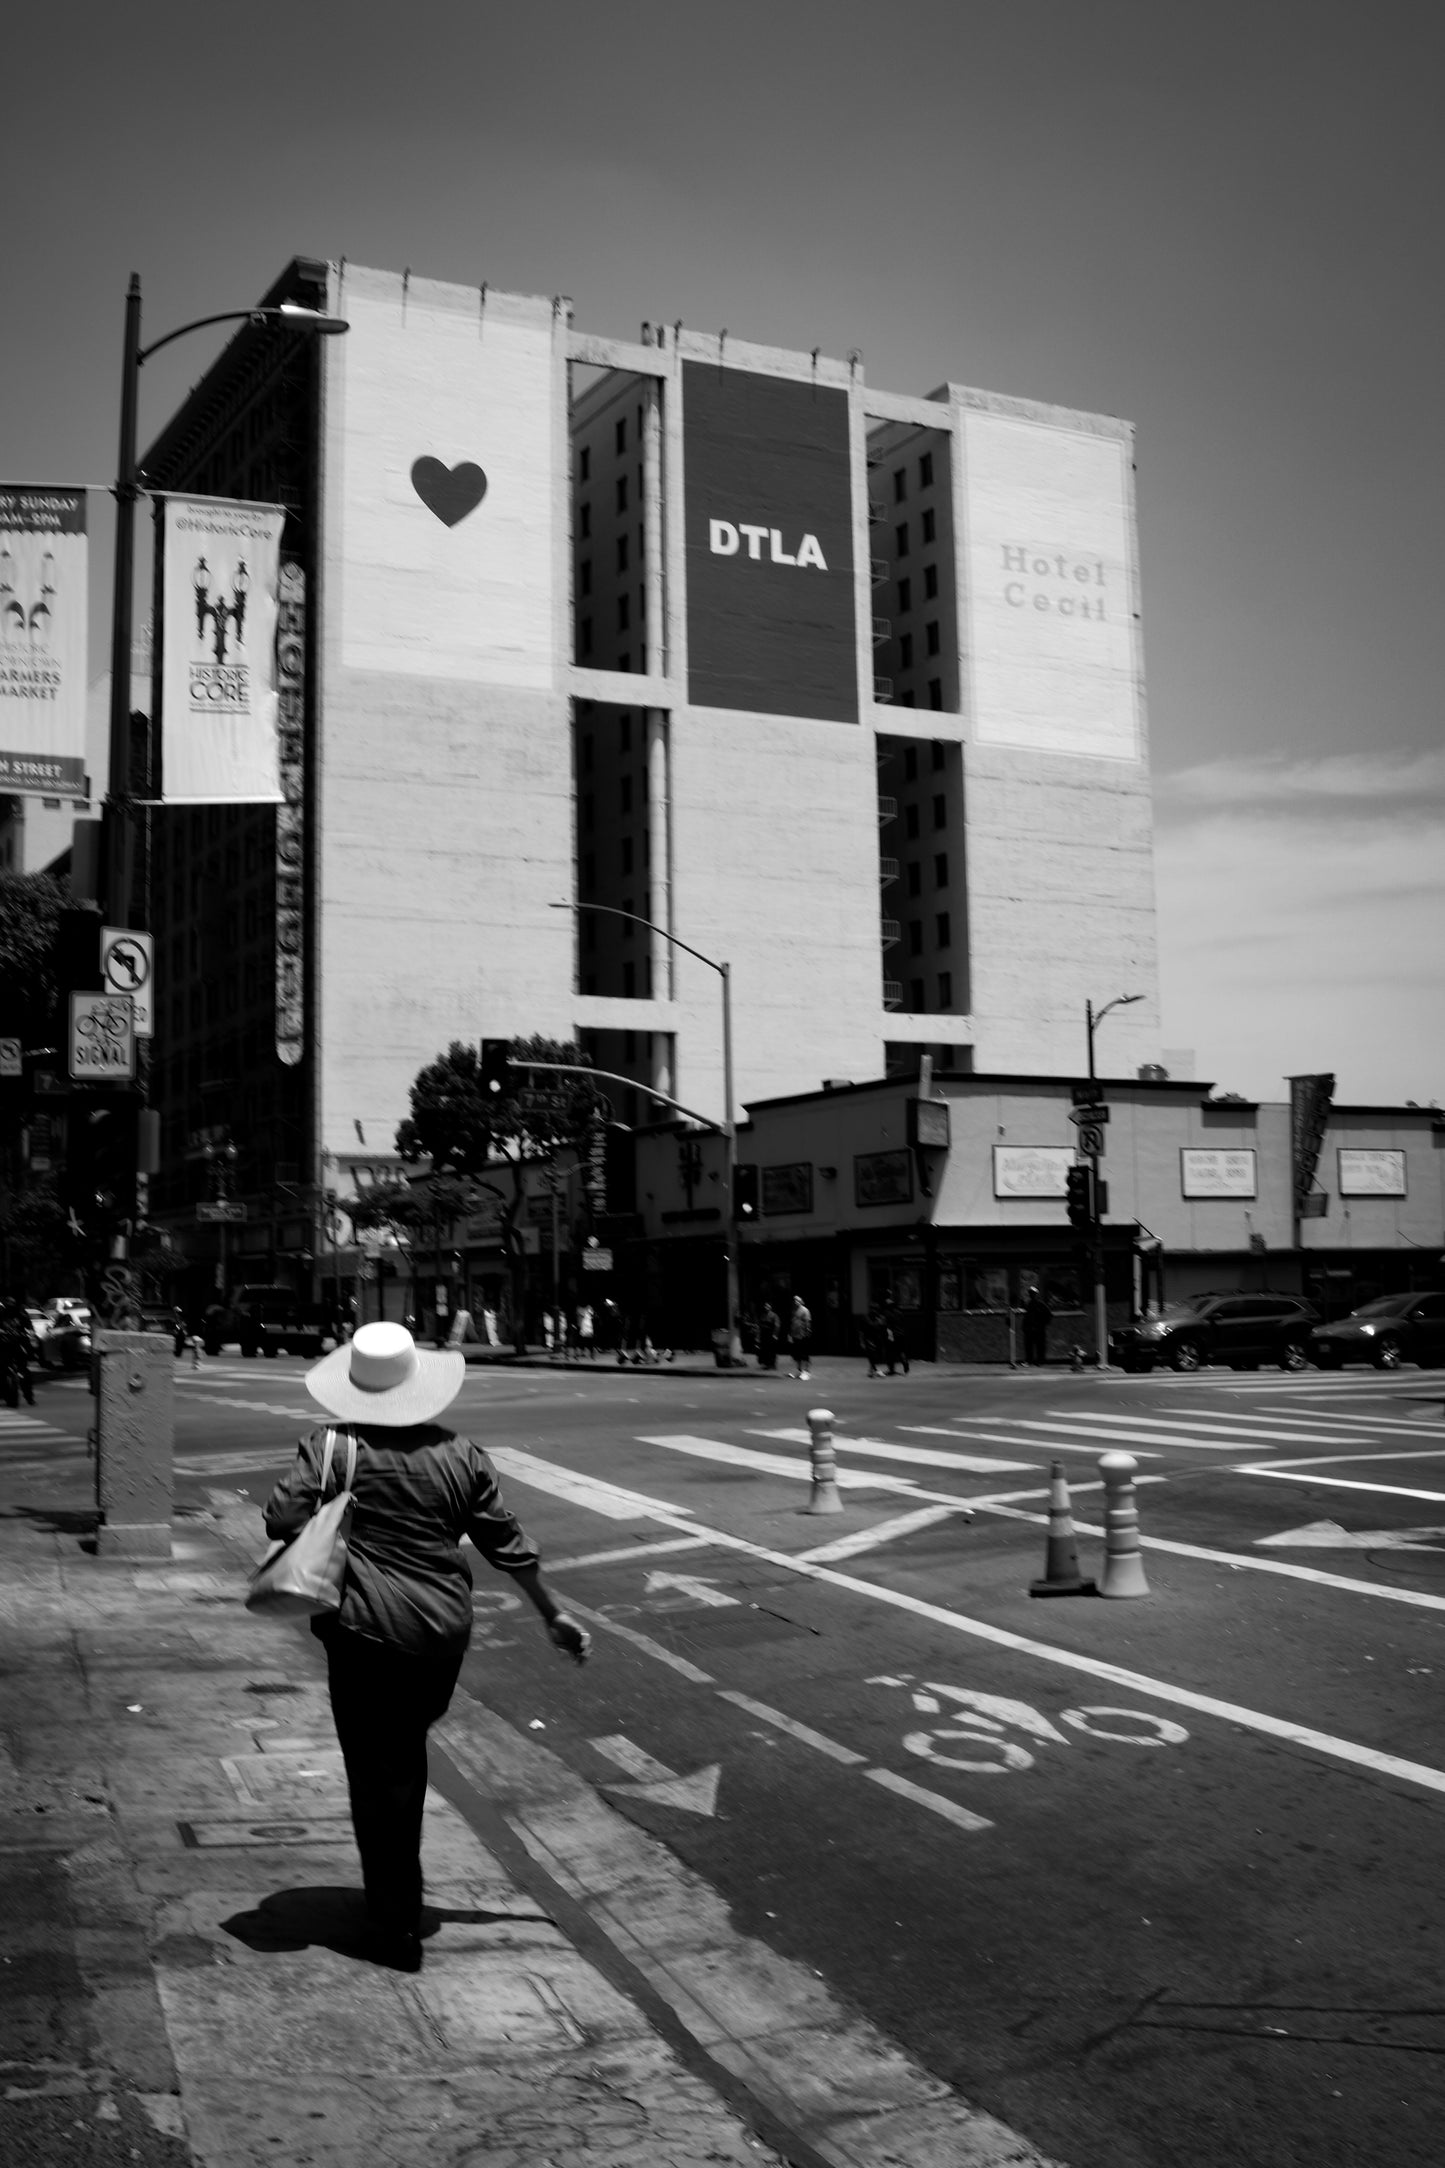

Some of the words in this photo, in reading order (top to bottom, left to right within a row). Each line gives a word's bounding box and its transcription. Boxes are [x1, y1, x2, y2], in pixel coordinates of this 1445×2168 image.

[19, 496, 79, 512] SUNDAY
[175, 515, 272, 540] @HistoricCore
[709, 518, 829, 571] DTLA
[1000, 544, 1108, 588] Hotel
[1003, 582, 1108, 623] Cecil
[189, 666, 249, 682] HISTORIC
[189, 681, 250, 702] CORE
[12, 760, 63, 778] STREET
[75, 1045, 129, 1066] SIGNAL
[550, 1093, 568, 1109] St
